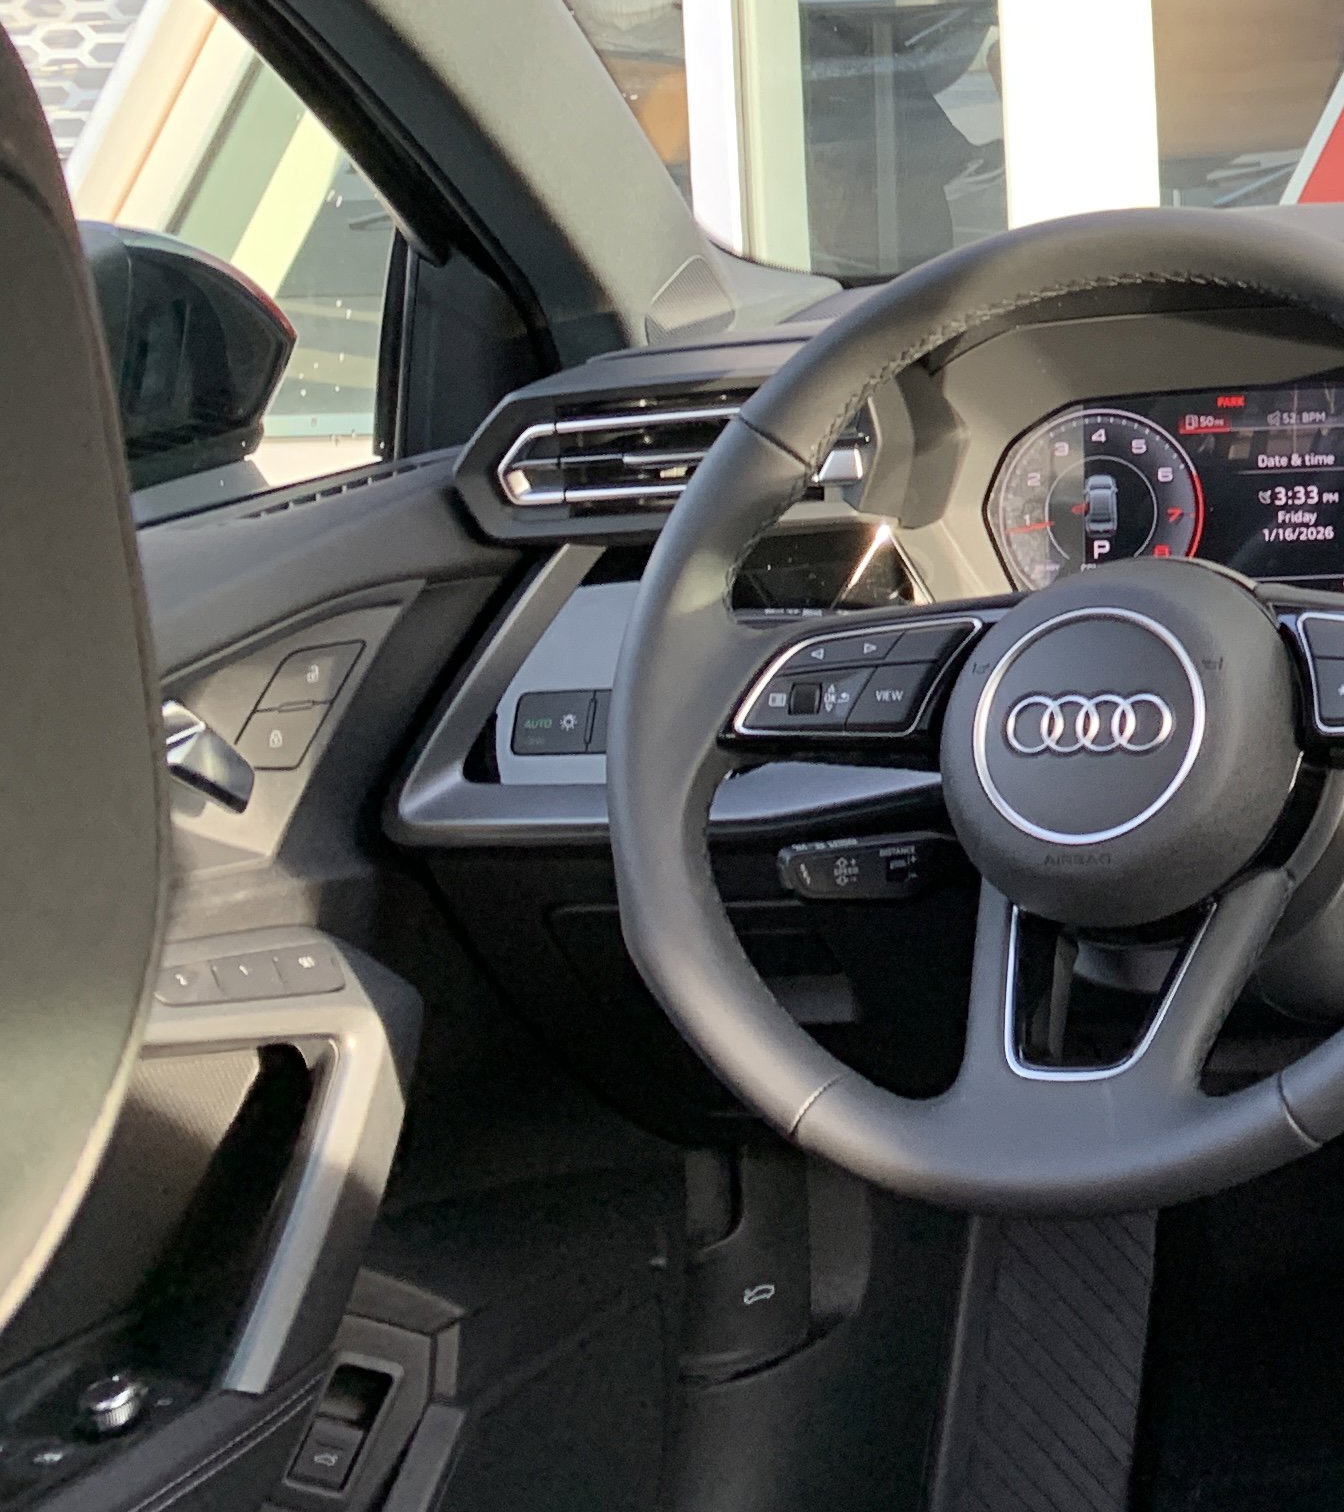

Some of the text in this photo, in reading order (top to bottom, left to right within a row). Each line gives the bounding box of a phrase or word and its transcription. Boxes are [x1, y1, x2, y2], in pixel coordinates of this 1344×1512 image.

[1091, 428, 1106, 443] 4
[1054, 441, 1069, 456] 3
[1131, 439, 1147, 454] 5
[1257, 452, 1335, 468] Date & time
[1027, 472, 1041, 486] 2
[1157, 467, 1173, 482] 6
[1274, 486, 1339, 506] 3:33 PM
[1023, 514, 1031, 525] 1
[1167, 507, 1183, 523] 7
[1277, 511, 1318, 526] Friday
[1262, 526, 1334, 542] 1/16/2026
[1093, 540, 1110, 560] P
[875, 690, 904, 702] VIEW
[524, 718, 553, 729] AUTO
[1043, 853, 1112, 866] AIRBAG
